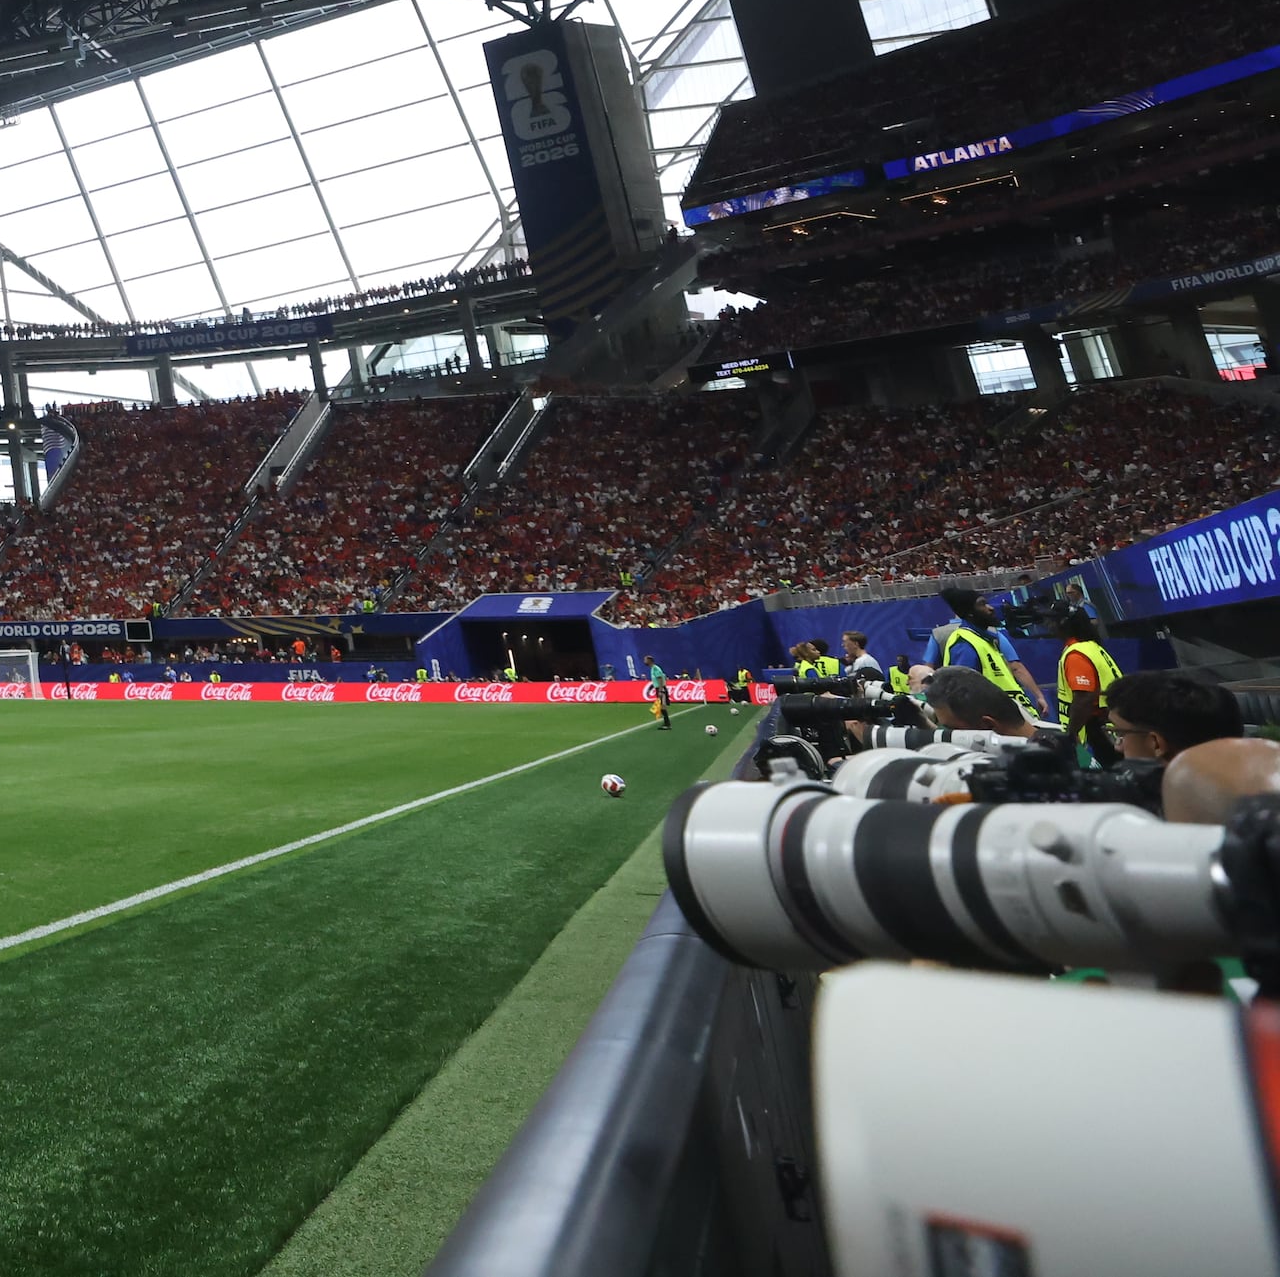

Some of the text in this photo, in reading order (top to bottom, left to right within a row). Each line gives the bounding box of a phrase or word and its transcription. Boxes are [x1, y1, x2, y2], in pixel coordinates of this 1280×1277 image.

[530, 118, 557, 132] FIFA
[519, 132, 577, 155] WORLD CUP
[520, 142, 580, 168] 2026
[913, 136, 1014, 171] ATLANTA
[1170, 274, 1202, 292] FIFA
[1201, 262, 1255, 285] WORLD
[1254, 258, 1274, 275] CUP
[137, 321, 318, 352] FIFA WORLD CUP 2026
[1148, 544, 1191, 601] FIFA
[1174, 527, 1241, 596] WORLD
[1230, 515, 1277, 586] CUP
[42, 624, 70, 636] CUP
[71, 623, 121, 636] 2026
